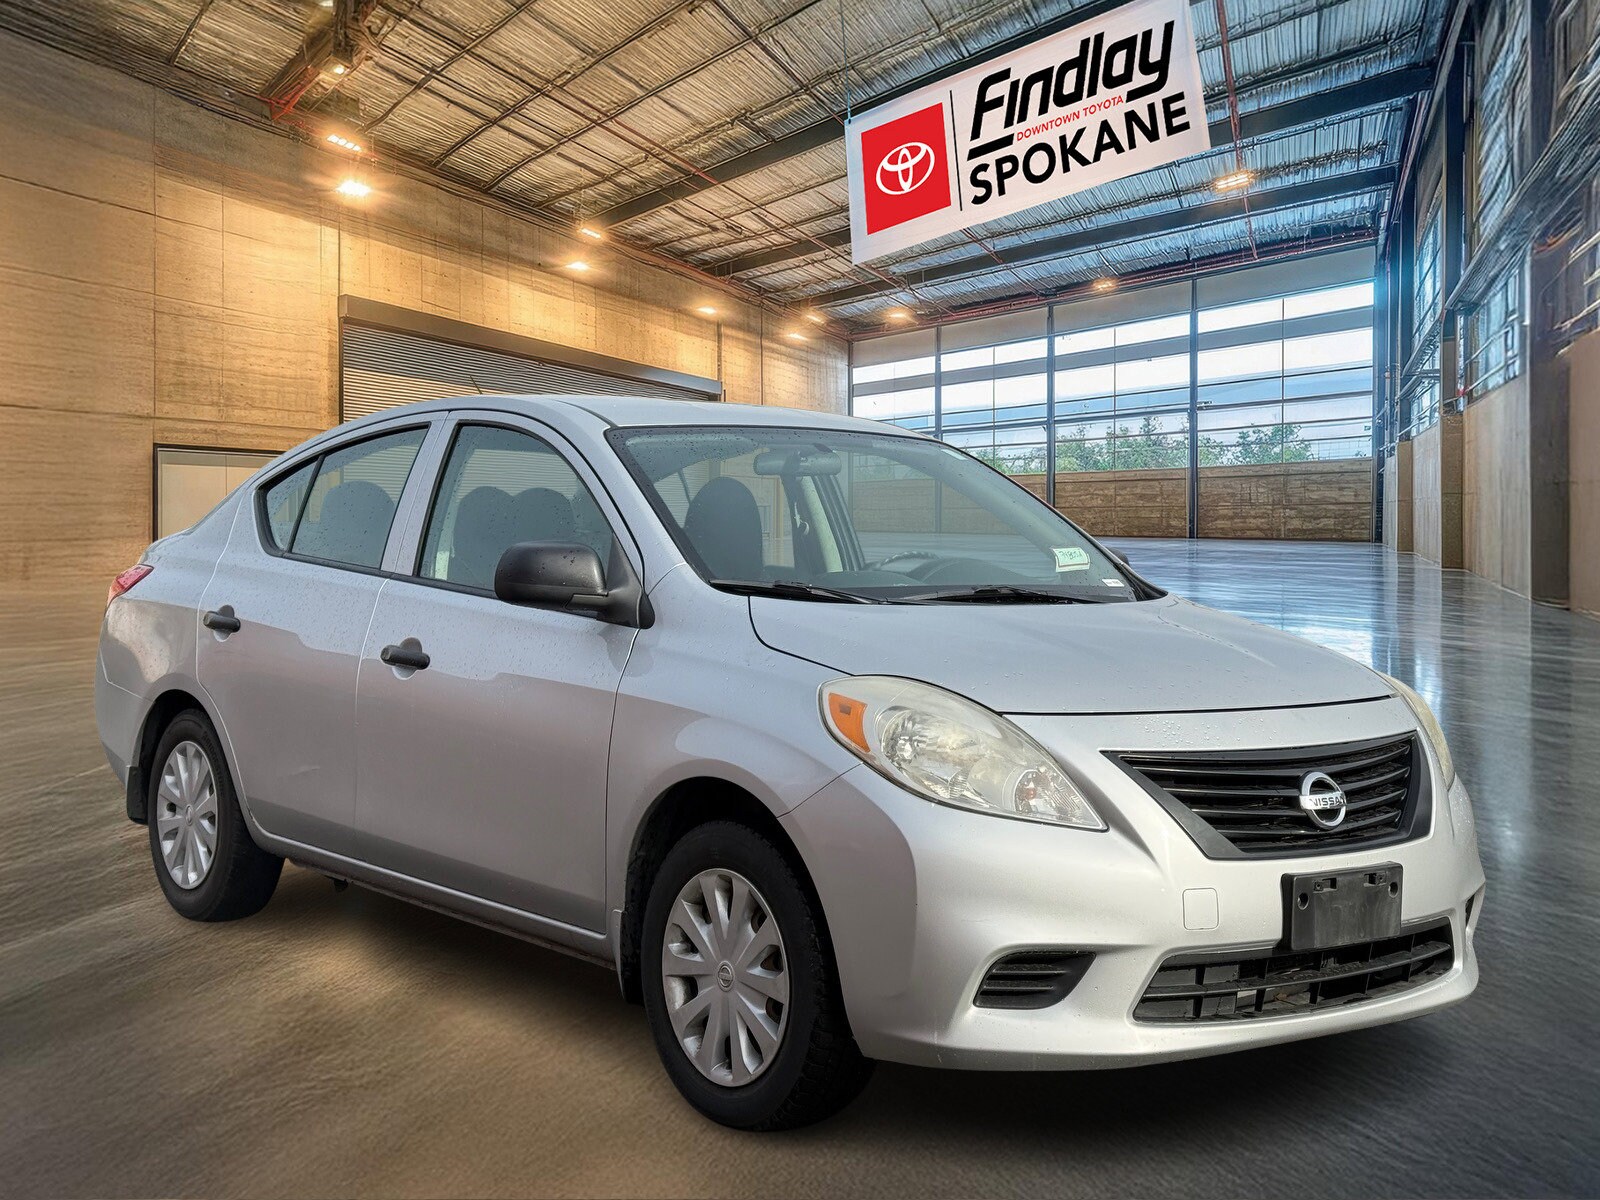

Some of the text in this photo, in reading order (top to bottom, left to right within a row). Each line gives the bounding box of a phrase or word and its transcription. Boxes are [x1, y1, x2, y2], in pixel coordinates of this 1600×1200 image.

[970, 20, 1175, 141] Findlay
[1017, 95, 1124, 141] DOWNTOWN TOYOTA
[969, 91, 1191, 205] SPOKANE
